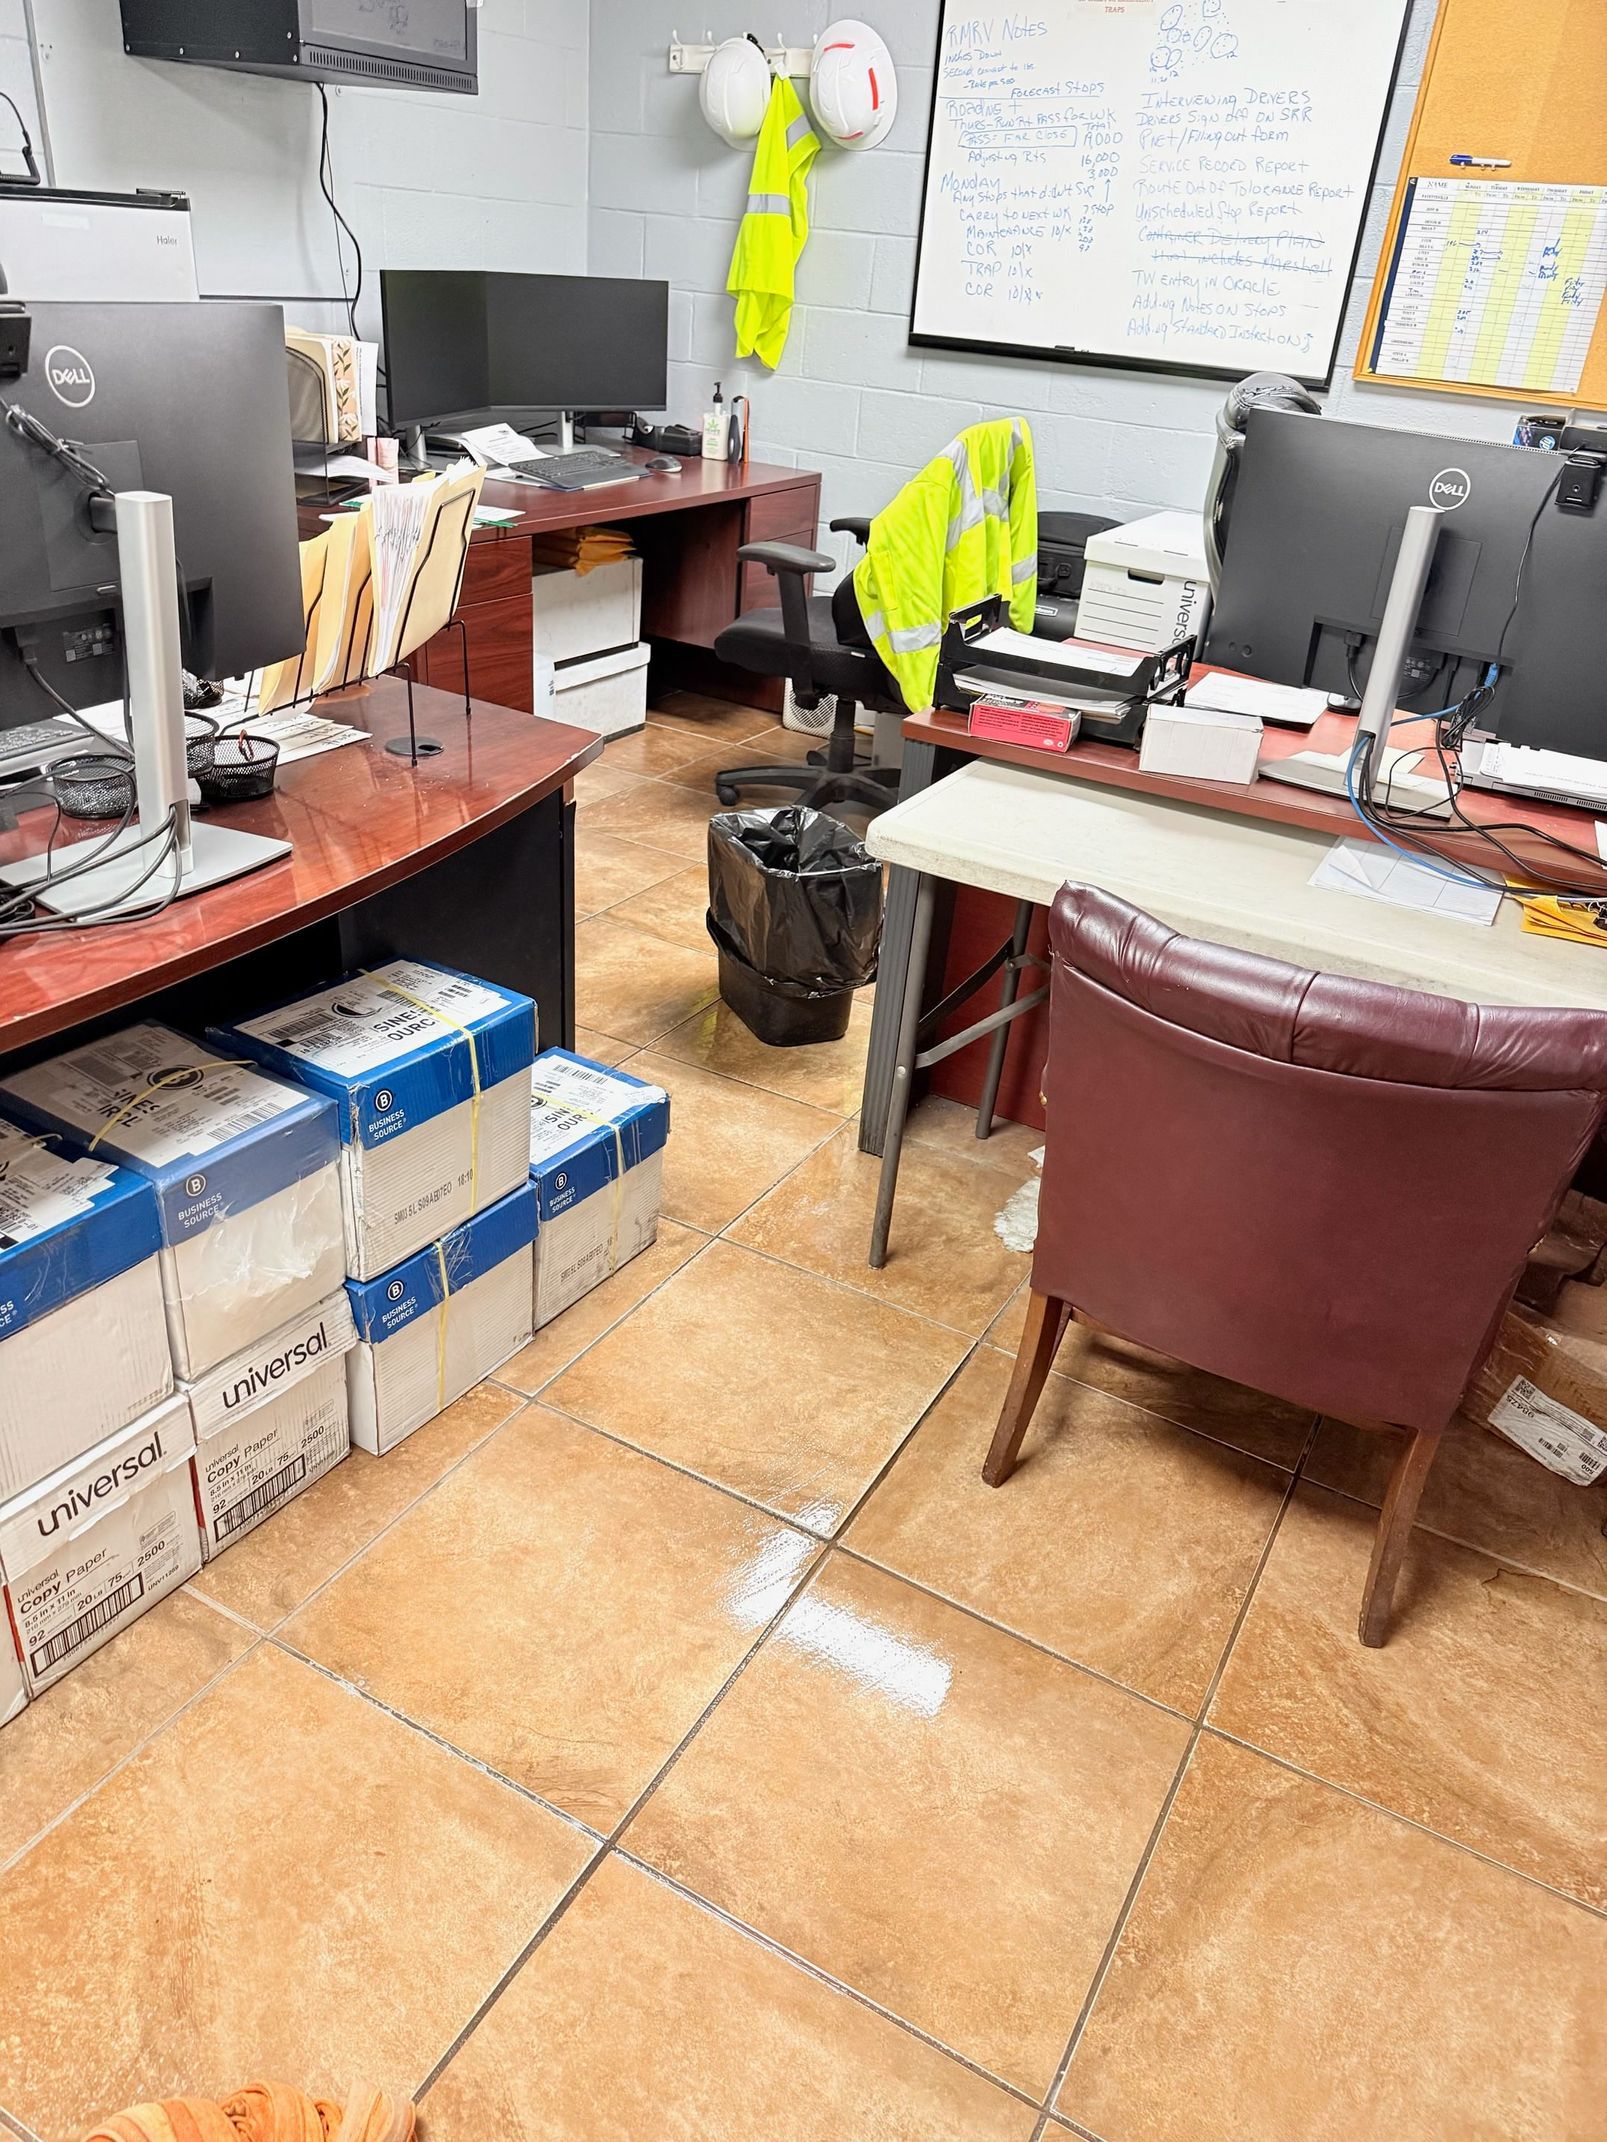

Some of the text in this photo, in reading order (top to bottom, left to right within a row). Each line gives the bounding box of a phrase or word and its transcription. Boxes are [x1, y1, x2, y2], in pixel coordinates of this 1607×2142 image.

[52, 368, 91, 385] DELL
[1434, 482, 1465, 497] DELL
[1172, 581, 1197, 644] univers
[368, 1109, 405, 1133] BUSINESS
[373, 1120, 403, 1141] SOURCE
[178, 1192, 223, 1221] BUSINESS
[549, 1187, 575, 1207] BUSINESS
[552, 1196, 573, 1213] SOURCE
[184, 1205, 219, 1229] SOURCE
[382, 1296, 417, 1323] BUSINESS
[387, 1307, 414, 1329] SOURCE
[222, 1322, 329, 1409] universal
[301, 1425, 325, 1449] 2500
[205, 1444, 239, 1473] universal
[207, 1429, 278, 1483] Copy Paper
[277, 1451, 289, 1466] 75
[37, 1431, 164, 1537] universal
[251, 1470, 265, 1485] 20
[212, 1499, 227, 1514] 92
[137, 1540, 165, 1567] 2500
[17, 1569, 59, 1602] universal
[20, 1548, 107, 1614] Copy Paper
[107, 1572, 123, 1588] 75
[39, 1607, 49, 1619] in
[56, 1596, 66, 1607] 11
[67, 1588, 77, 1600] in
[77, 1589, 104, 1612] 20 LB
[28, 1629, 46, 1647] 92
